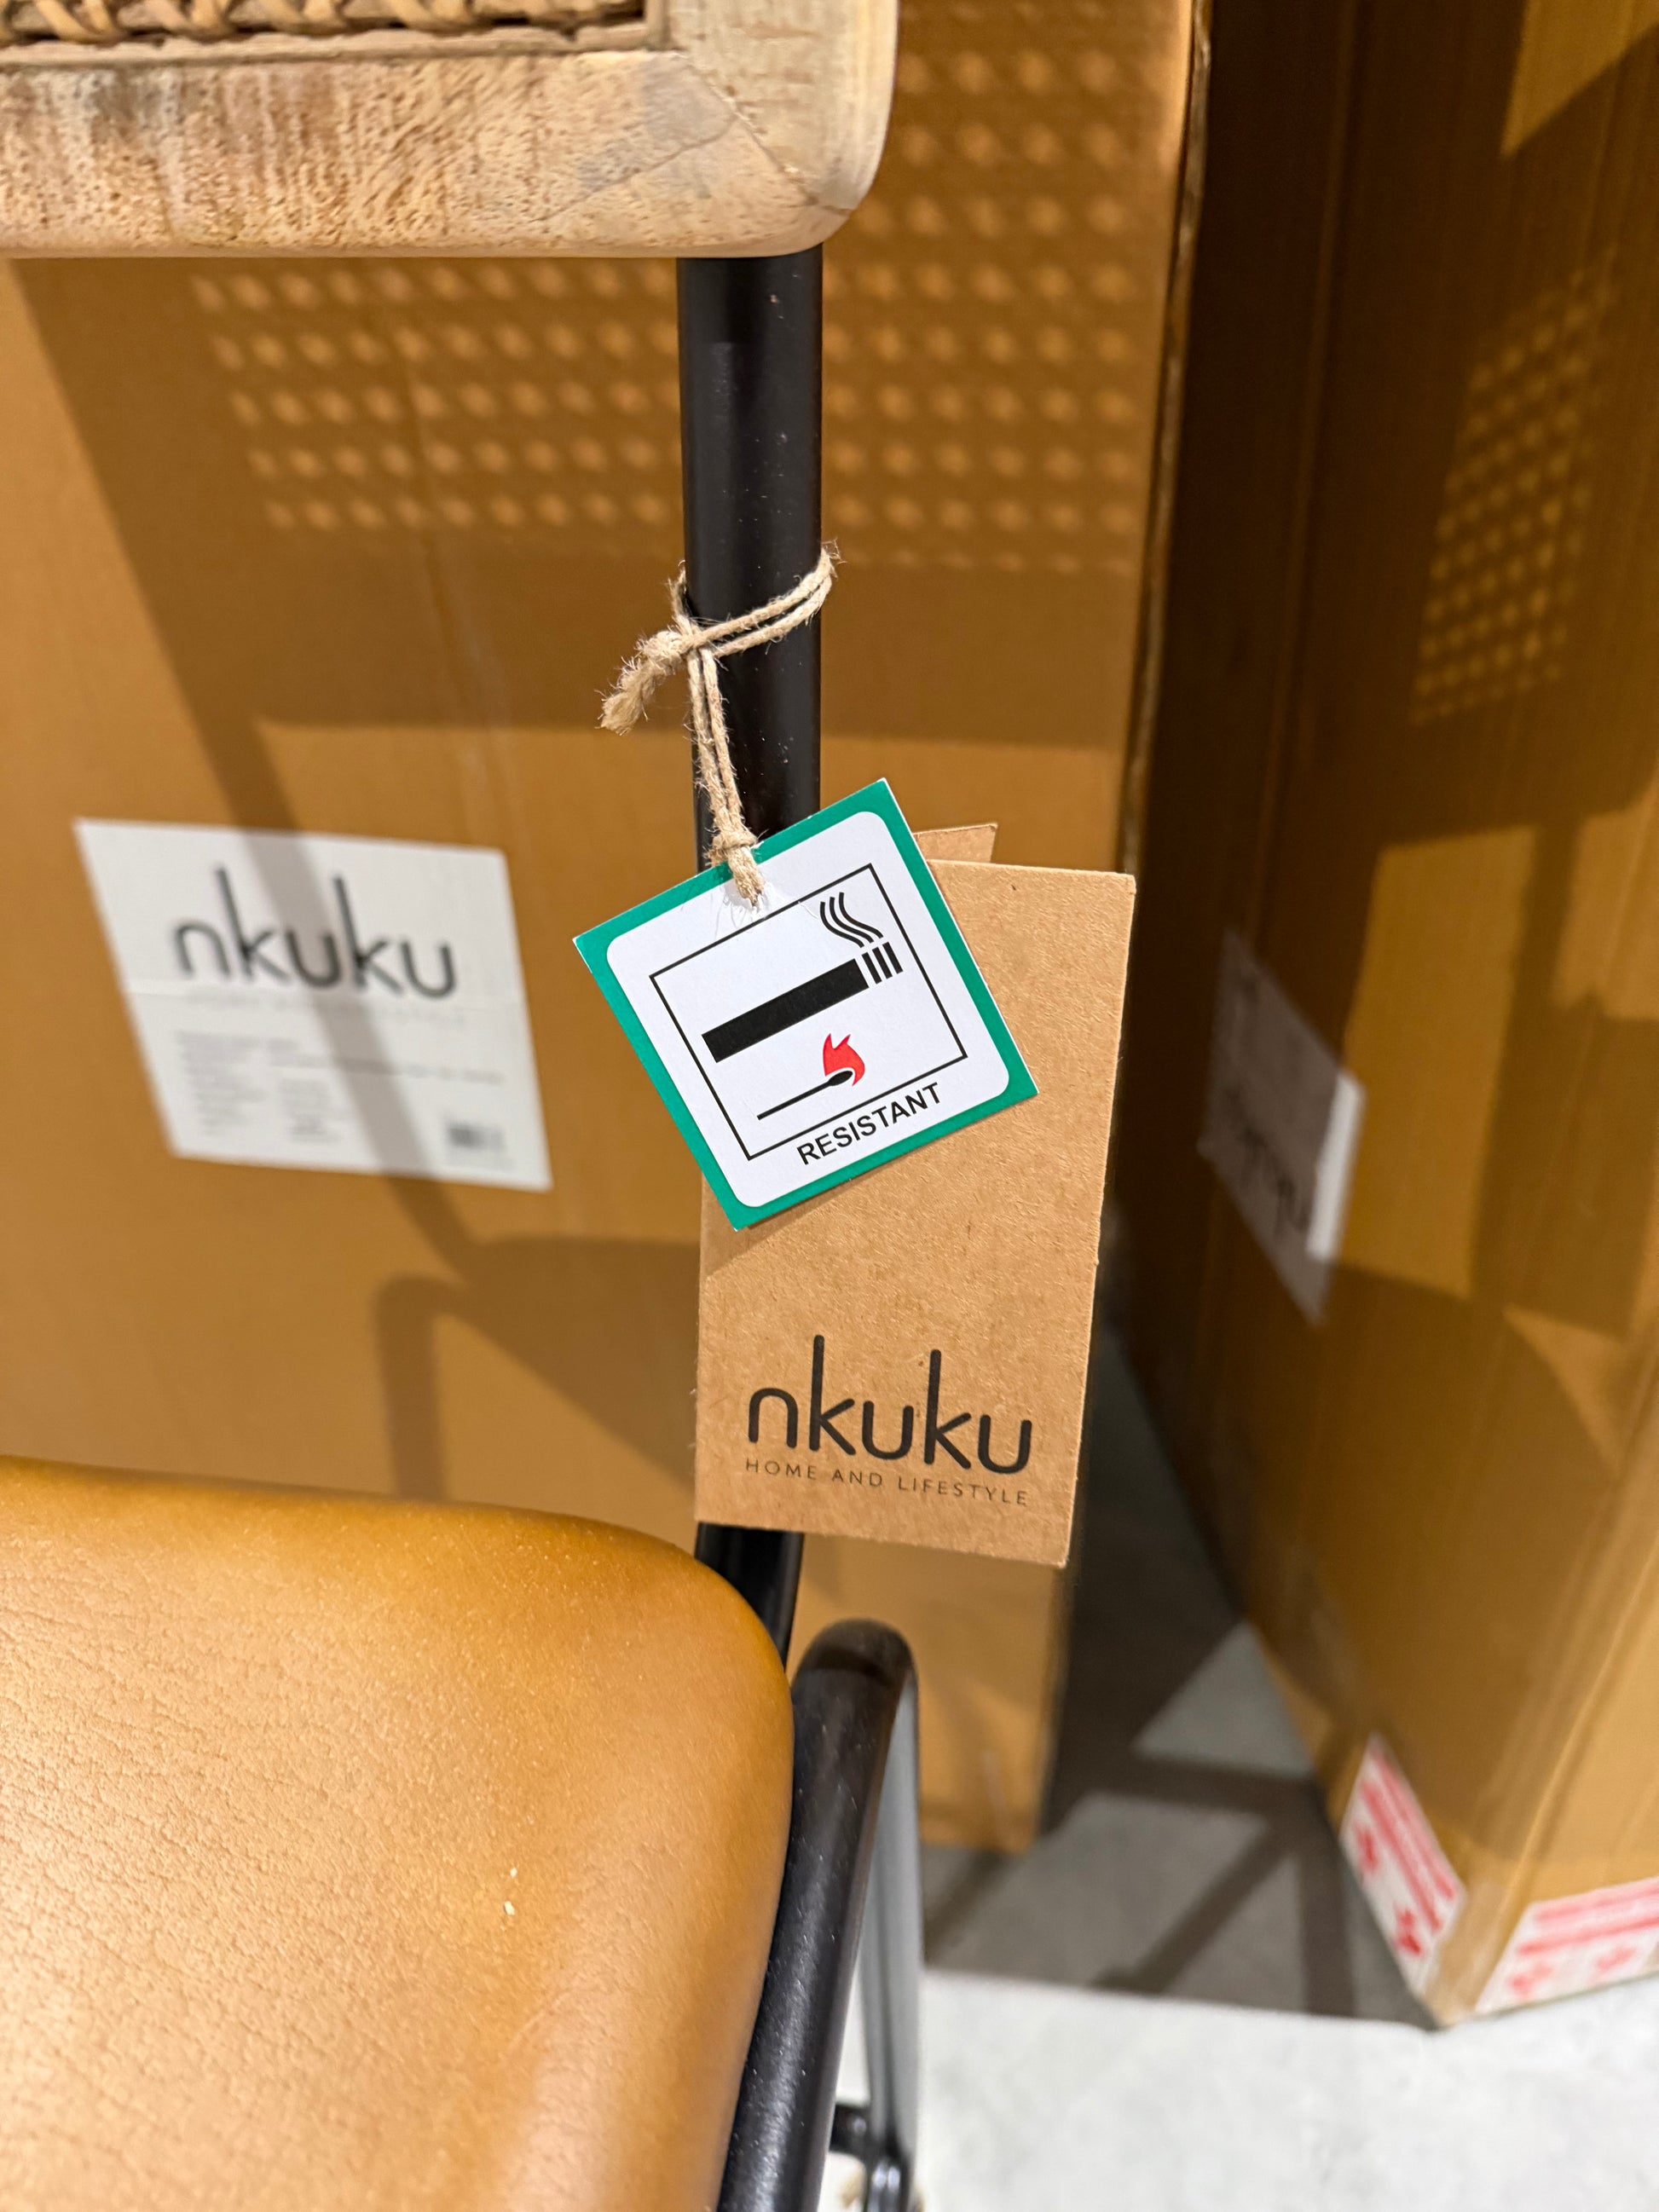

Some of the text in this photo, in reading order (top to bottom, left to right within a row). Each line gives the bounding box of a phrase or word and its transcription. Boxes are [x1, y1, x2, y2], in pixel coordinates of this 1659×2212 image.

[171, 864, 458, 1000] nkuku
[796, 1082, 942, 1165] RESISTANT
[748, 1334, 1032, 1475] nkuku
[745, 1458, 1029, 1506] HOME AND LIFESTYLE
